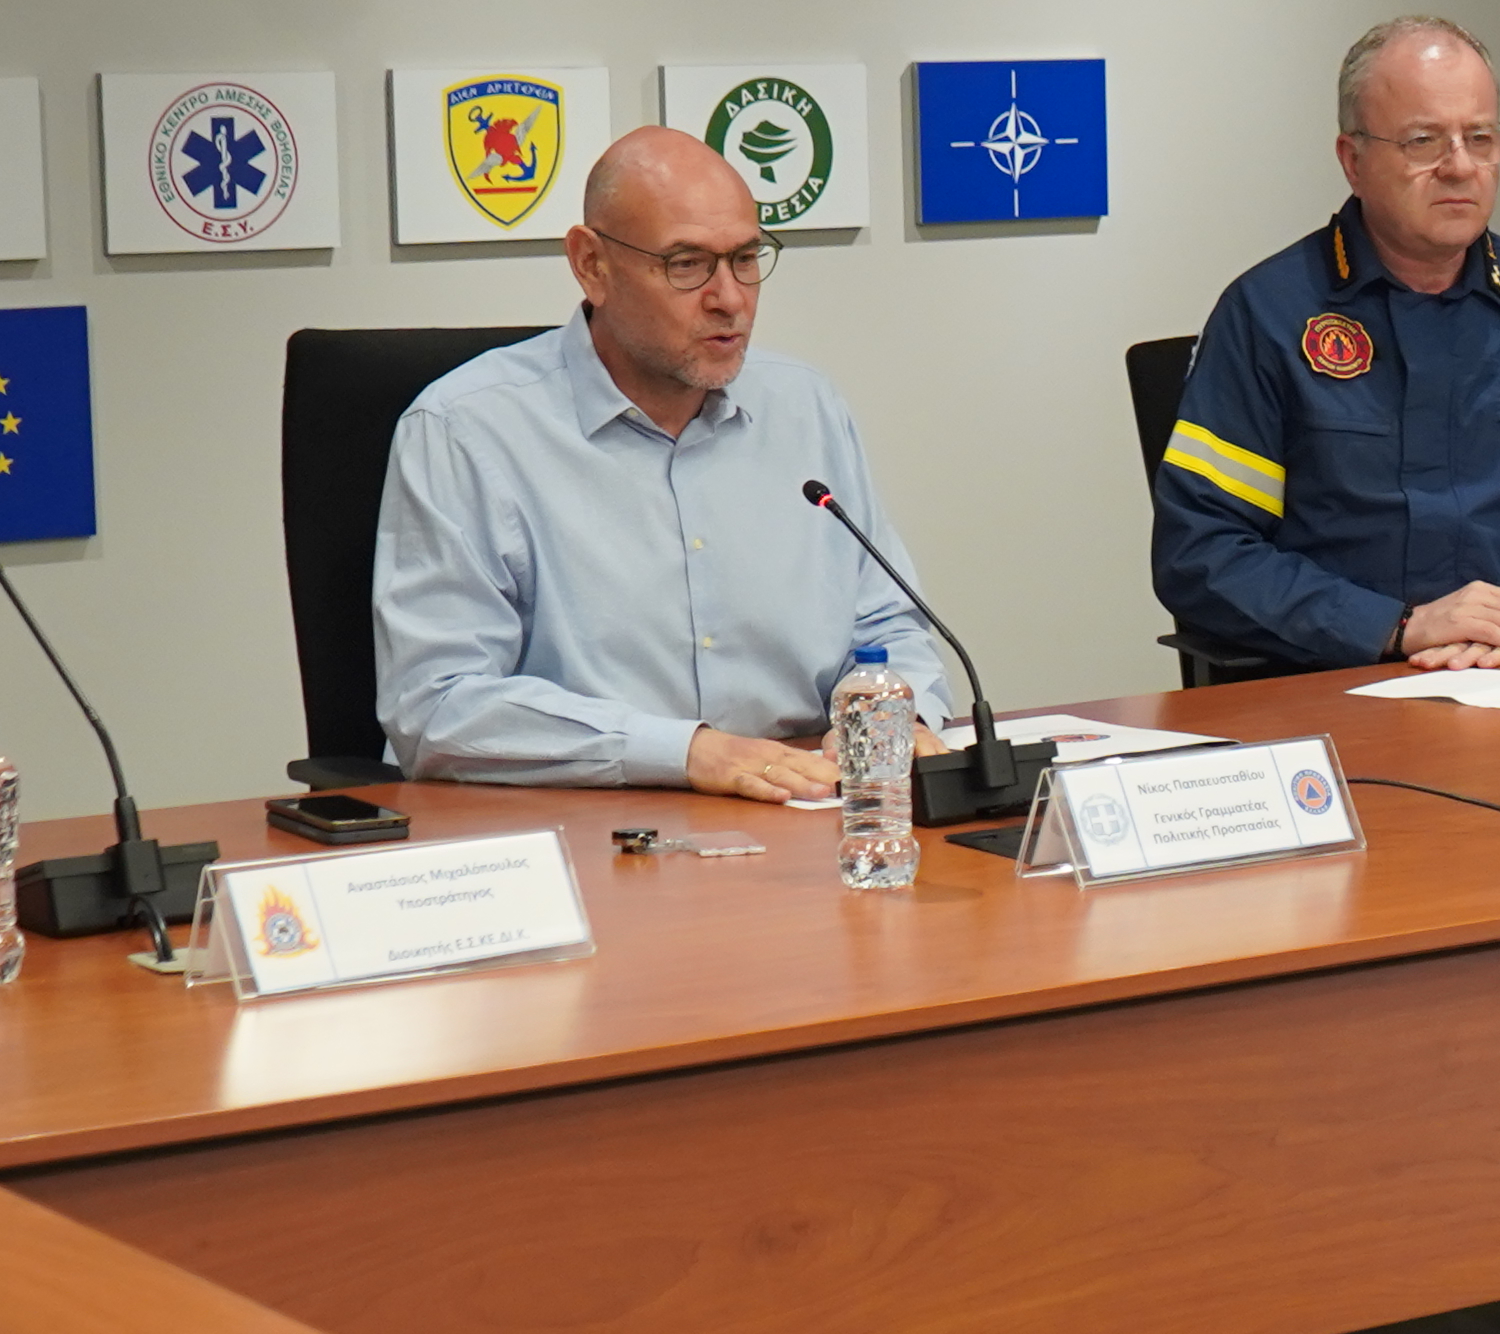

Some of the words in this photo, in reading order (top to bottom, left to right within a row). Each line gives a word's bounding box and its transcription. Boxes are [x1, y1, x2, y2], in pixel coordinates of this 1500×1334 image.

[161, 92, 209, 138] ΚΕΝΤΡΟ
[215, 88, 273, 121] ΑΜΕΣΗΣ
[725, 82, 813, 119] ΔΑΣΙΚΗ
[154, 142, 176, 203] ΕΘΝΙΚΟ
[270, 119, 294, 200] ΒΟΗΘΕΙΑΣ
[760, 176, 824, 222] ΡΕΣΙΑ
[1137, 782, 1173, 796] Νίκος
[1172, 769, 1266, 791] Παπαευσταθίου
[1153, 808, 1198, 825] Γενικός
[1198, 799, 1269, 820] Γραμματέας
[1153, 827, 1211, 845] Πολιτικής
[1211, 816, 1282, 839] Προστασίας
[347, 871, 428, 894] Αναστάσιος
[429, 857, 530, 881] Μιχαλόπουλος
[396, 886, 495, 910] Υποστράτηγος
[387, 940, 454, 962] Διοικητής
